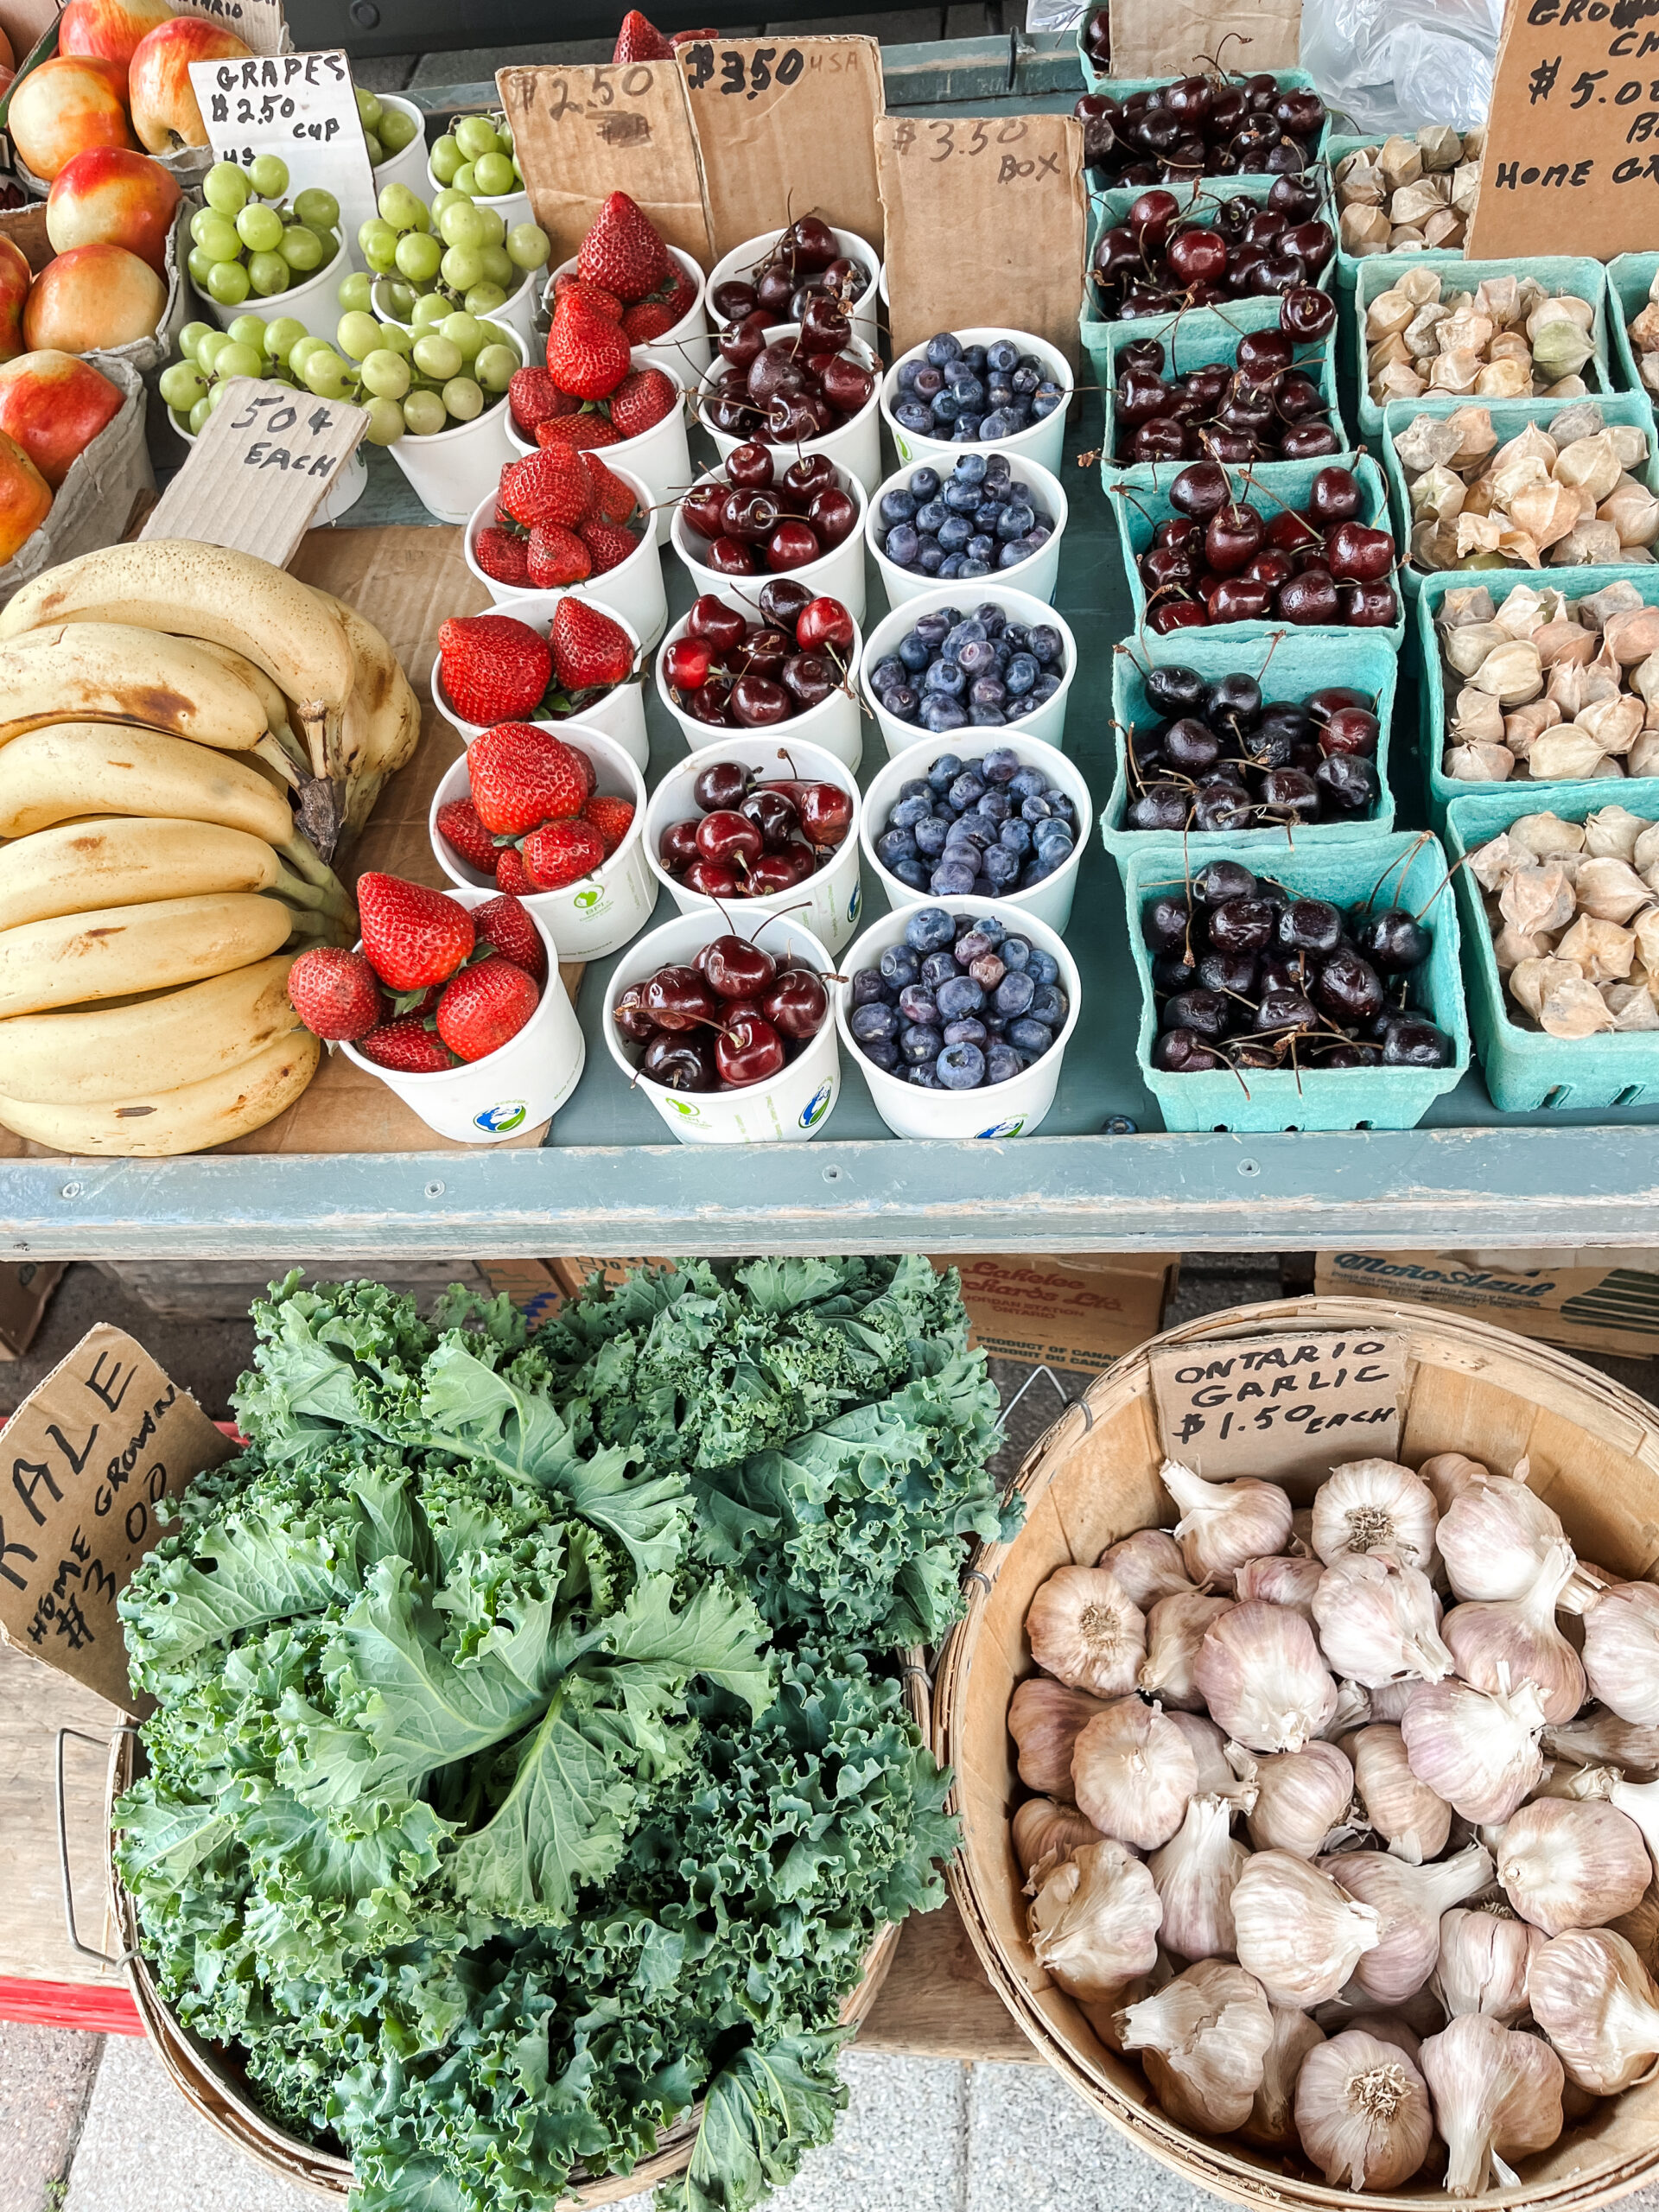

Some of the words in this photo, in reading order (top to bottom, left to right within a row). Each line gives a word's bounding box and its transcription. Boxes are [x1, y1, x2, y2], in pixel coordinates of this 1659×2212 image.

[217, 55, 345, 92] GRAPES
[686, 43, 804, 100] $3.50
[810, 51, 858, 73] USA
[212, 93, 295, 124] $2.50
[892, 120, 1028, 162] $3.50
[997, 152, 1061, 184] BOX
[1495, 160, 1594, 189] HOME
[244, 442, 337, 477] EACH
[962, 1262, 1086, 1290] Lakelee
[962, 1280, 1058, 1301] chards
[993, 1306, 1055, 1319] ONTARIO
[1023, 1302, 1085, 1316] STATION
[976, 1335, 1045, 1351] PRODUCT
[1048, 1345, 1067, 1355] OF
[1046, 1353, 1065, 1363] DU
[1070, 1357, 1111, 1369] CANA
[1174, 1341, 1385, 1384] ONTARIO
[1192, 1364, 1389, 1408] GARLIC
[1172, 1404, 1316, 1445] $1.50
[1304, 1407, 1396, 1434] EACH
[0, 1351, 138, 1591] KALE
[27, 1524, 91, 1645] HOME
